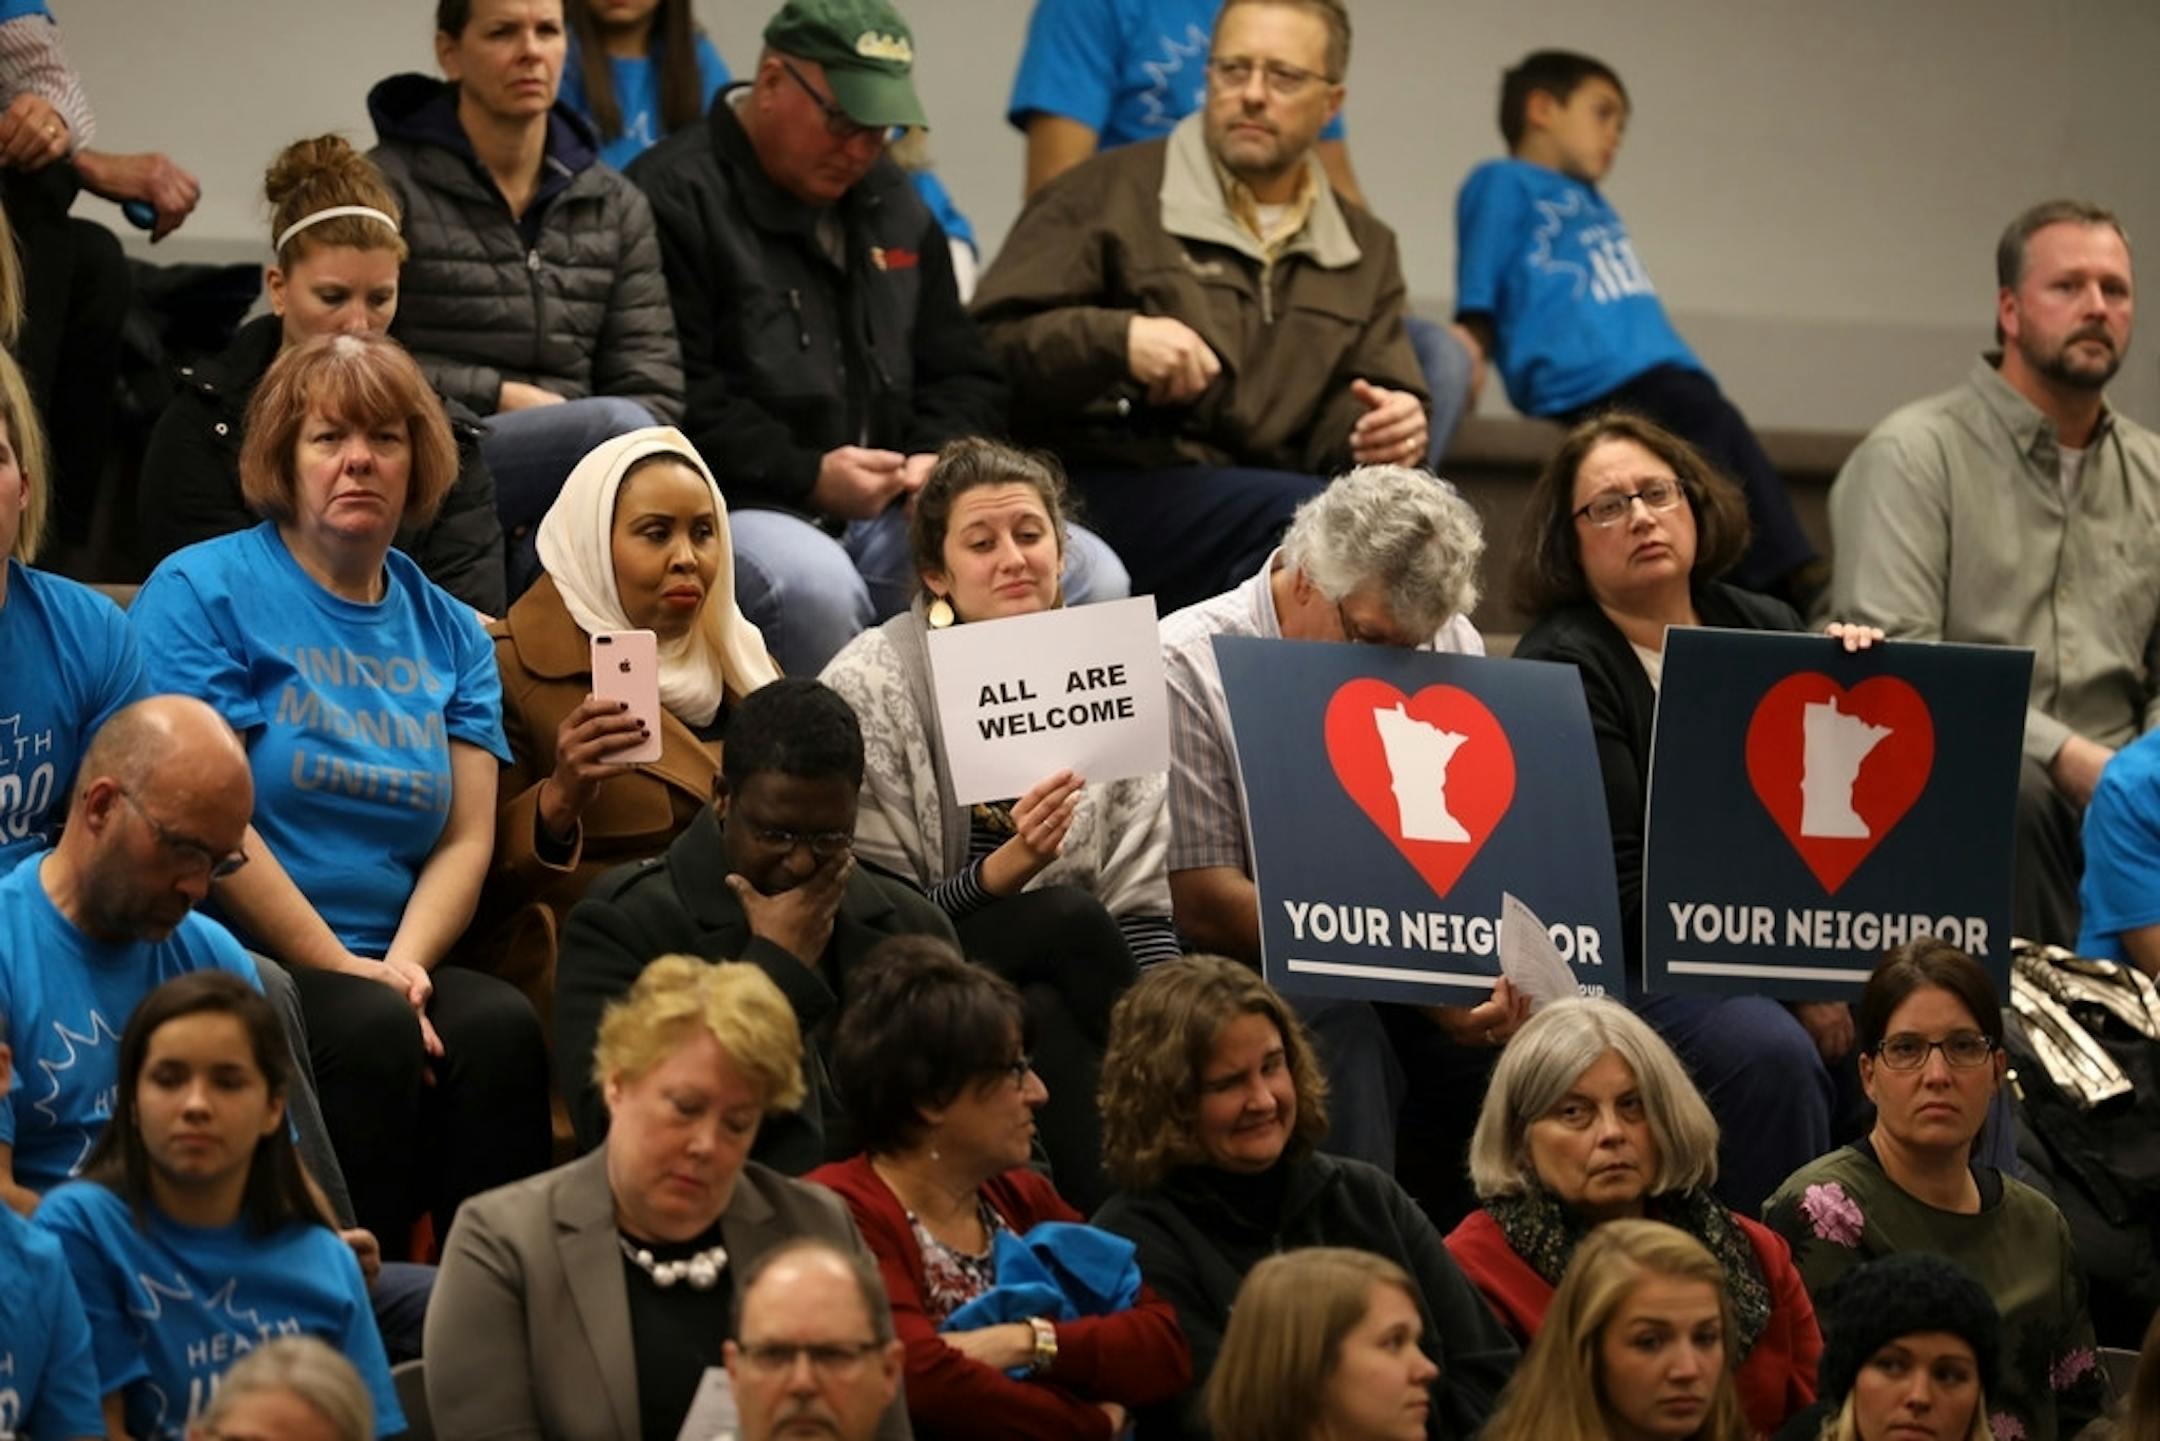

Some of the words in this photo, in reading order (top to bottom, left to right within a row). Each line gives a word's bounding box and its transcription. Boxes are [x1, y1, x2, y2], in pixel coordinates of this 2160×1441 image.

[979, 679, 1037, 707] ALL
[1066, 664, 1127, 693] ARE
[978, 696, 1135, 740] WELCOME
[1284, 901, 1391, 947] YOUR
[1401, 910, 1602, 965] NEIGOR
[1668, 902, 1775, 946] YOUR
